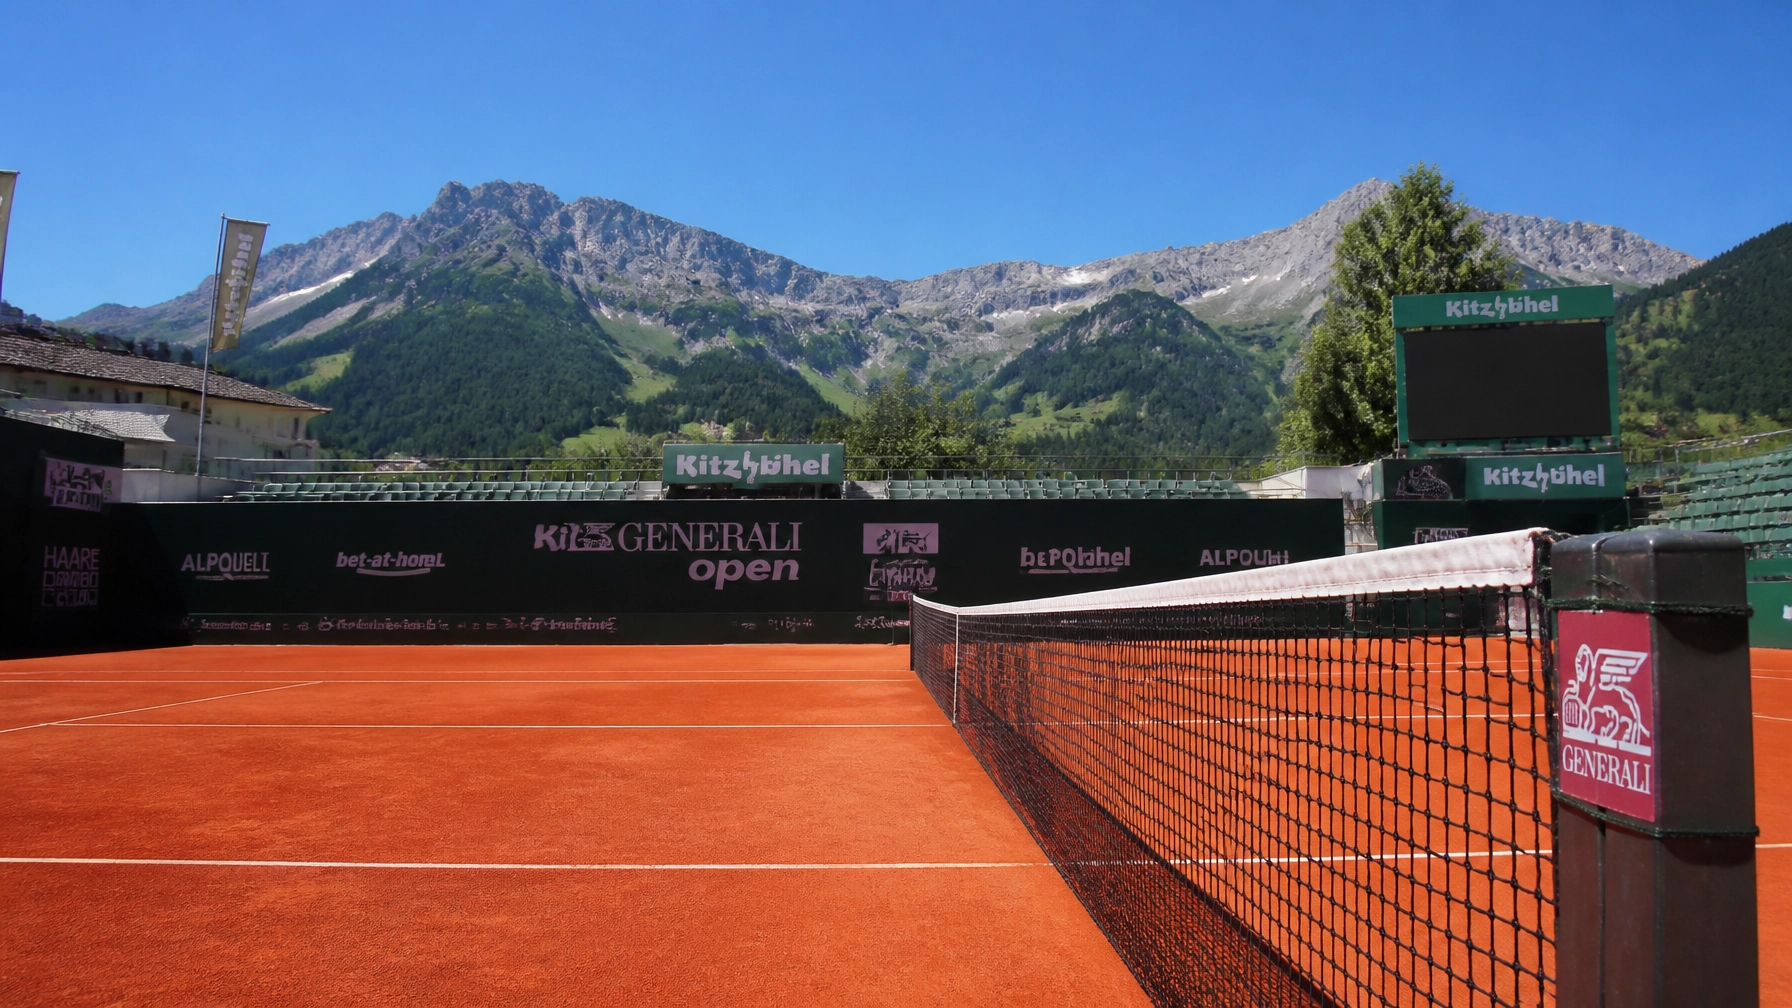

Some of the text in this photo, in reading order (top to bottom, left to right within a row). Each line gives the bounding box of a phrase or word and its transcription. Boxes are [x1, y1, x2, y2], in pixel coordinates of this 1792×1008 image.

[618, 522, 803, 551] GENERALI
[44, 546, 100, 570] HAARE
[688, 558, 799, 590] open
[1562, 744, 1652, 795] GENERALI
